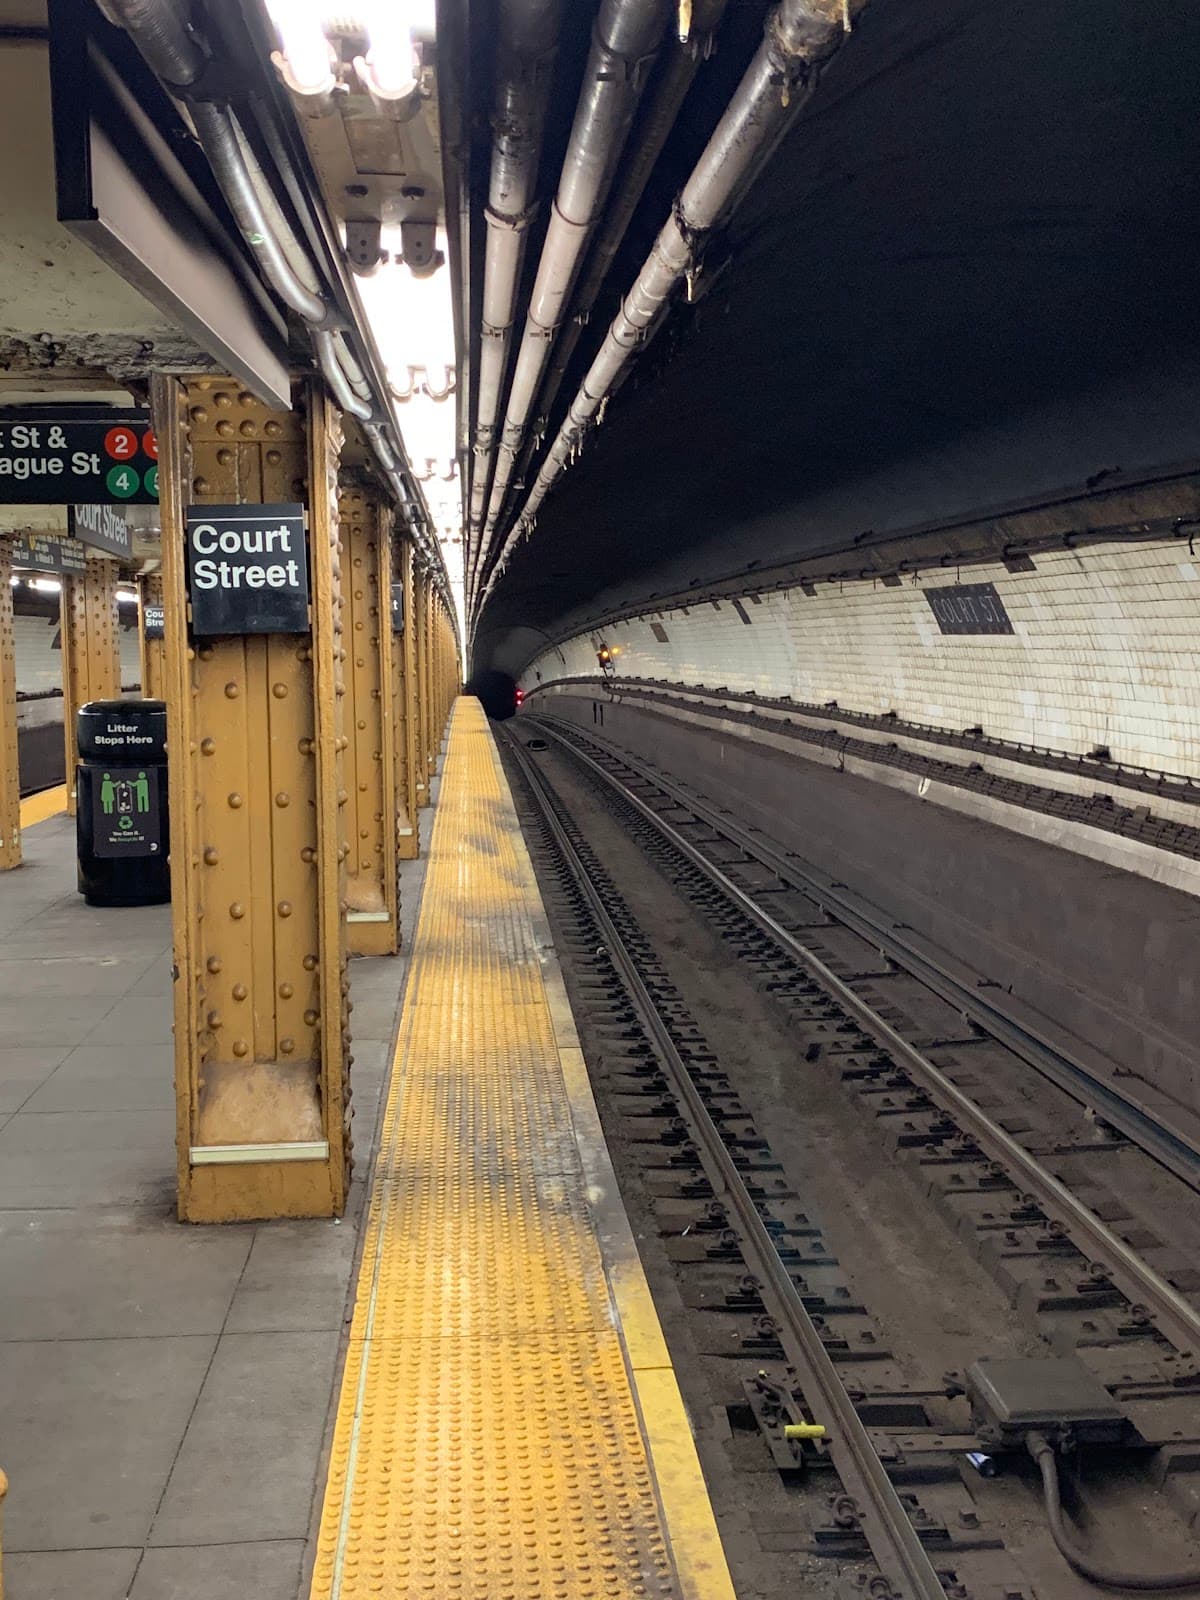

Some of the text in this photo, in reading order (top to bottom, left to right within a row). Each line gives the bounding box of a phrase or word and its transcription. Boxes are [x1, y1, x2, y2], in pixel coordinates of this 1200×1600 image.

[11, 425, 41, 449] St
[47, 425, 68, 449] &
[114, 434, 129, 454] 2
[71, 451, 101, 476] St
[115, 472, 130, 491] 4
[192, 524, 292, 555] Court
[194, 559, 300, 590] Street
[933, 597, 980, 623] COURT
[107, 723, 139, 733] Litter
[94, 735, 154, 746] Stops Here
